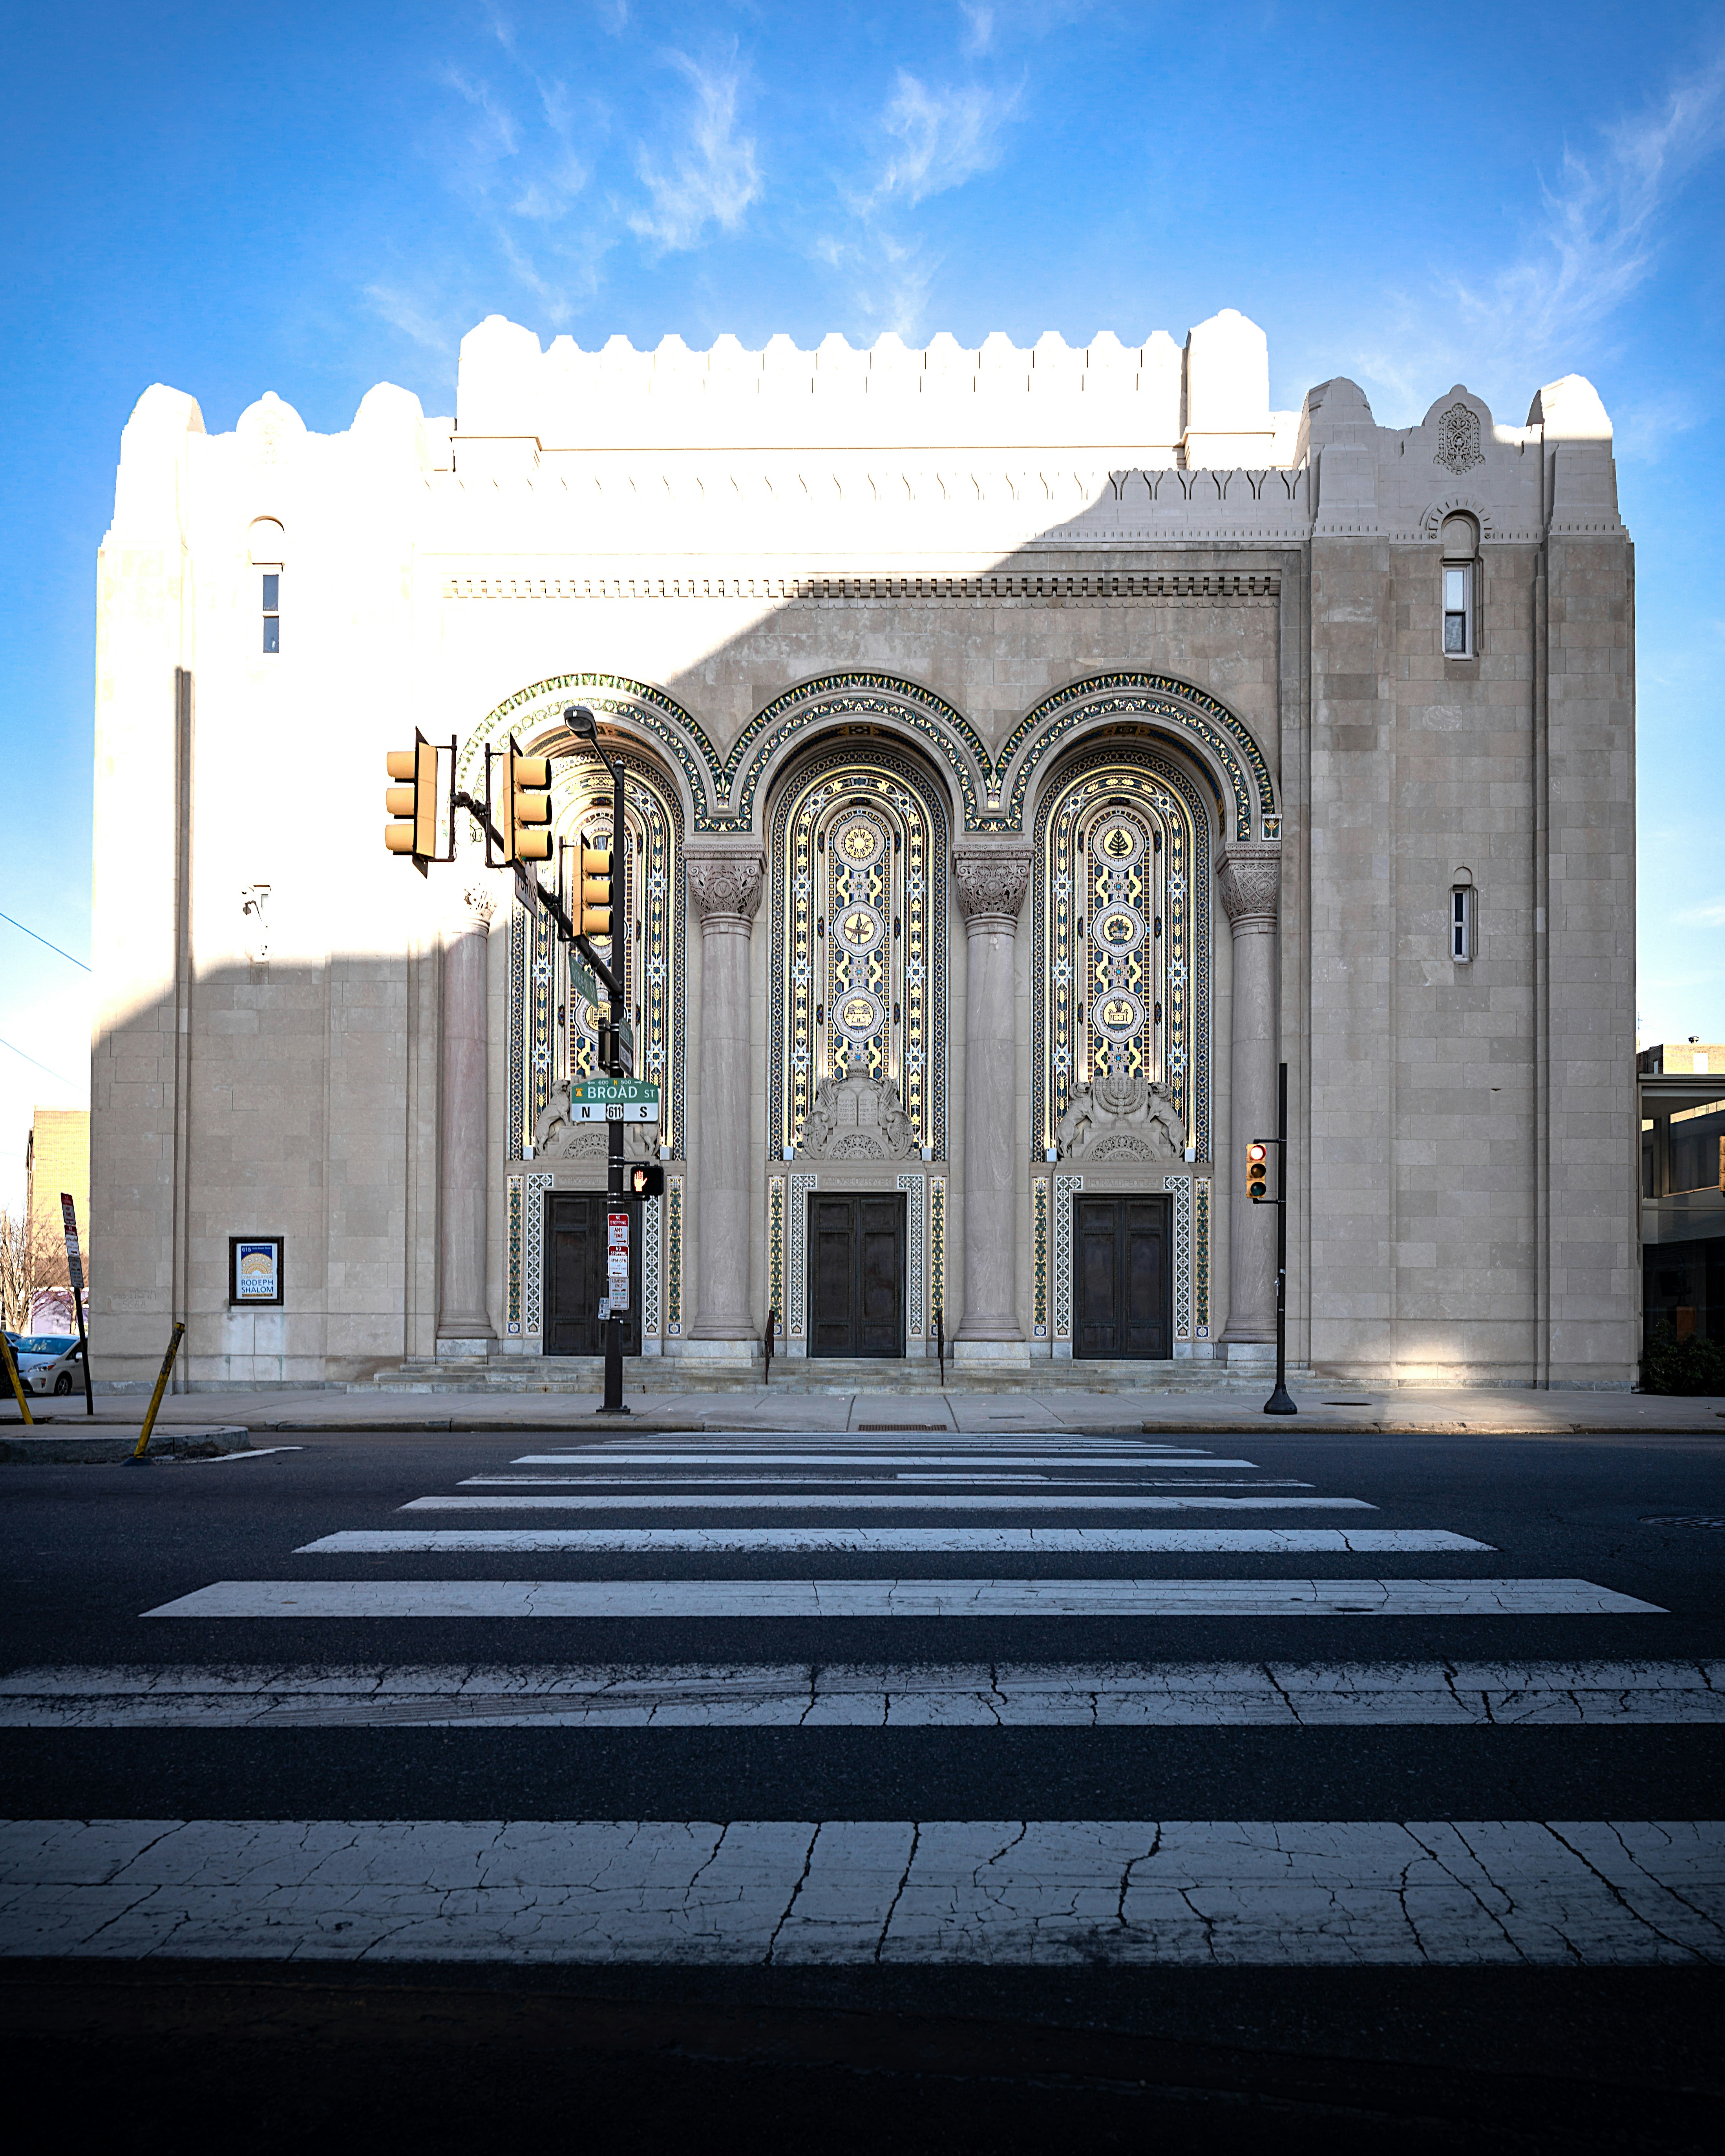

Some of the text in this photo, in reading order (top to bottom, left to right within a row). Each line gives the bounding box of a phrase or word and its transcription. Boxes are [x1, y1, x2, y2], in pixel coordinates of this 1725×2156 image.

[572, 962, 596, 1001] Green St
[588, 1086, 655, 1098] BROAD ST
[582, 1106, 647, 1118] N 611 S
[122, 1300, 146, 1309] 5688
